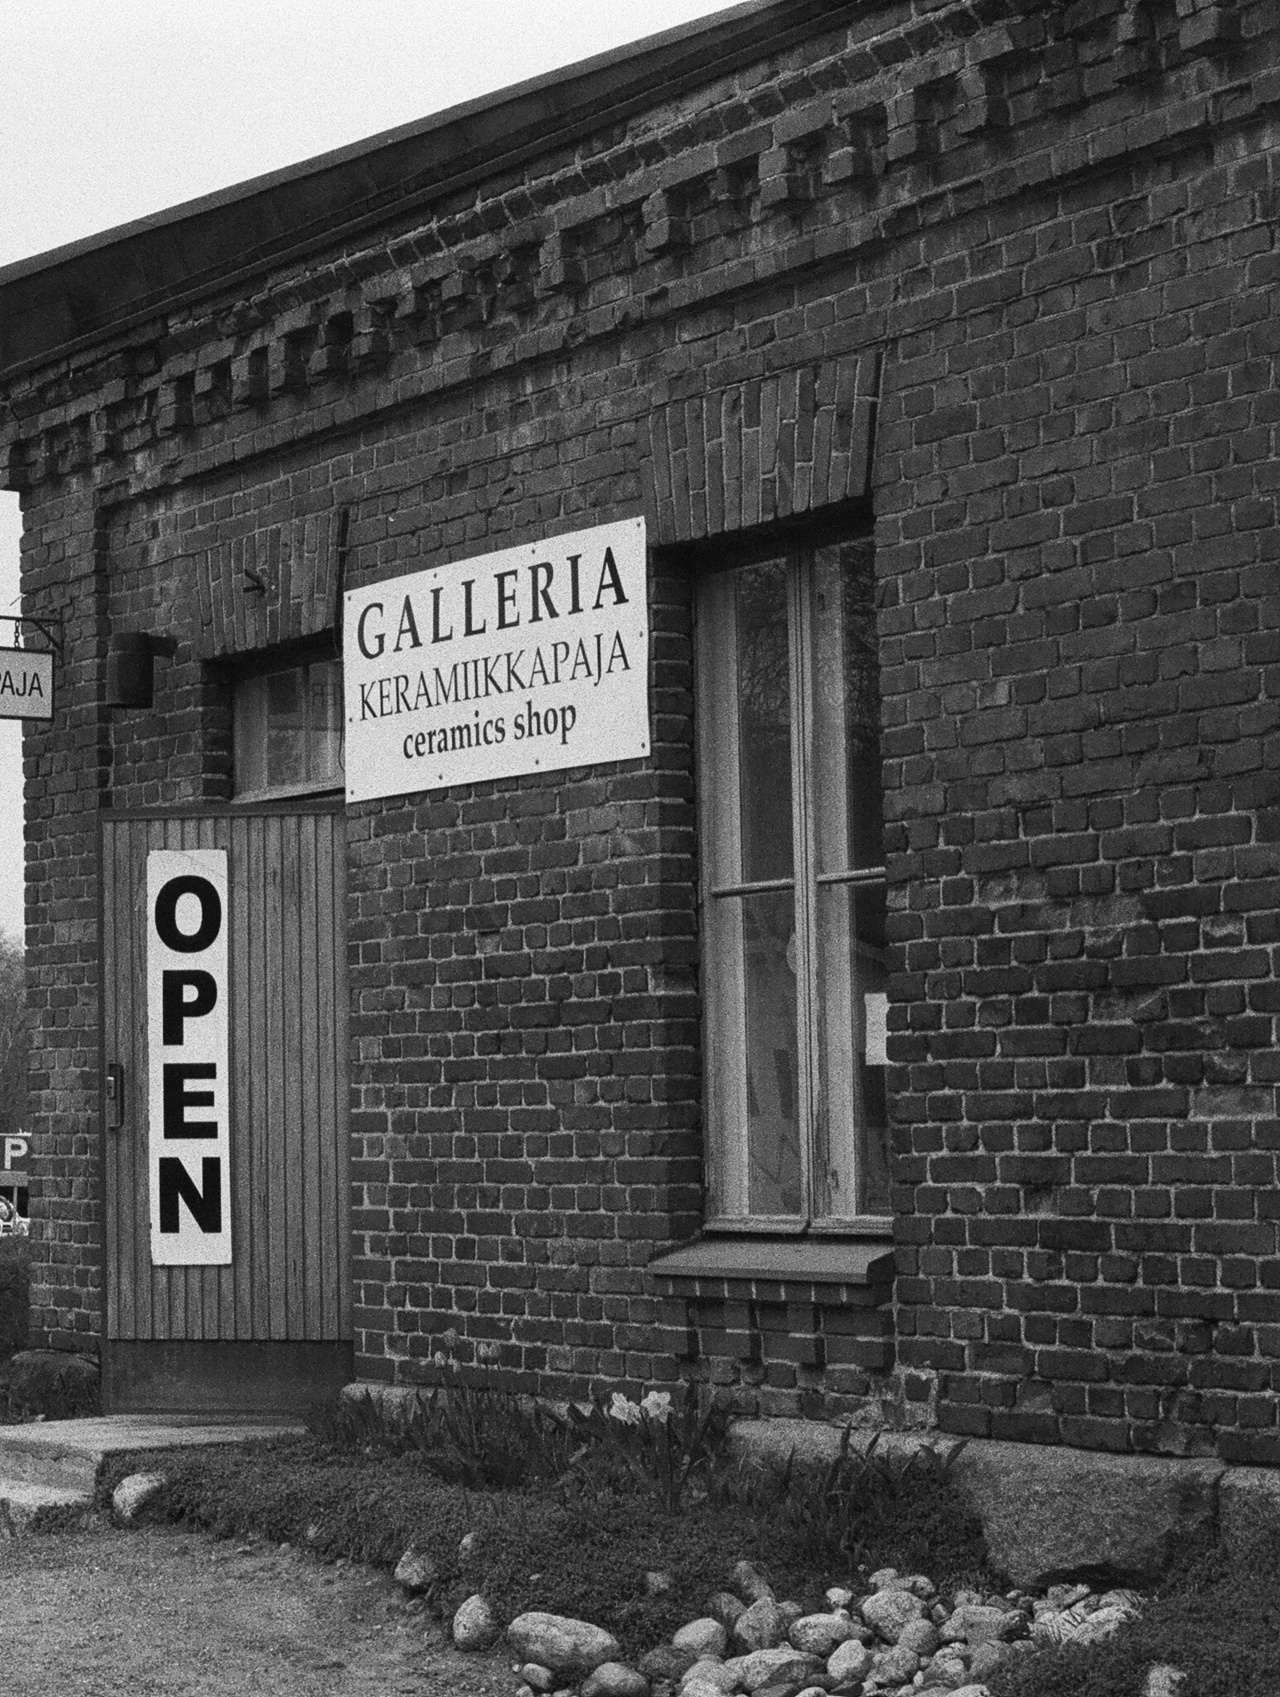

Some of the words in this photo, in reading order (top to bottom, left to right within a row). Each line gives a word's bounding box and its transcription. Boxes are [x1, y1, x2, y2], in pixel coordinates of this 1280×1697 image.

[357, 546, 630, 660] GALLERIA
[359, 630, 631, 722] KERAMIIKKAPAJA
[403, 710, 506, 759] ceramics
[514, 700, 577, 745] shop
[154, 875, 222, 1234] OPEN
[4, 1137, 28, 1170] P
